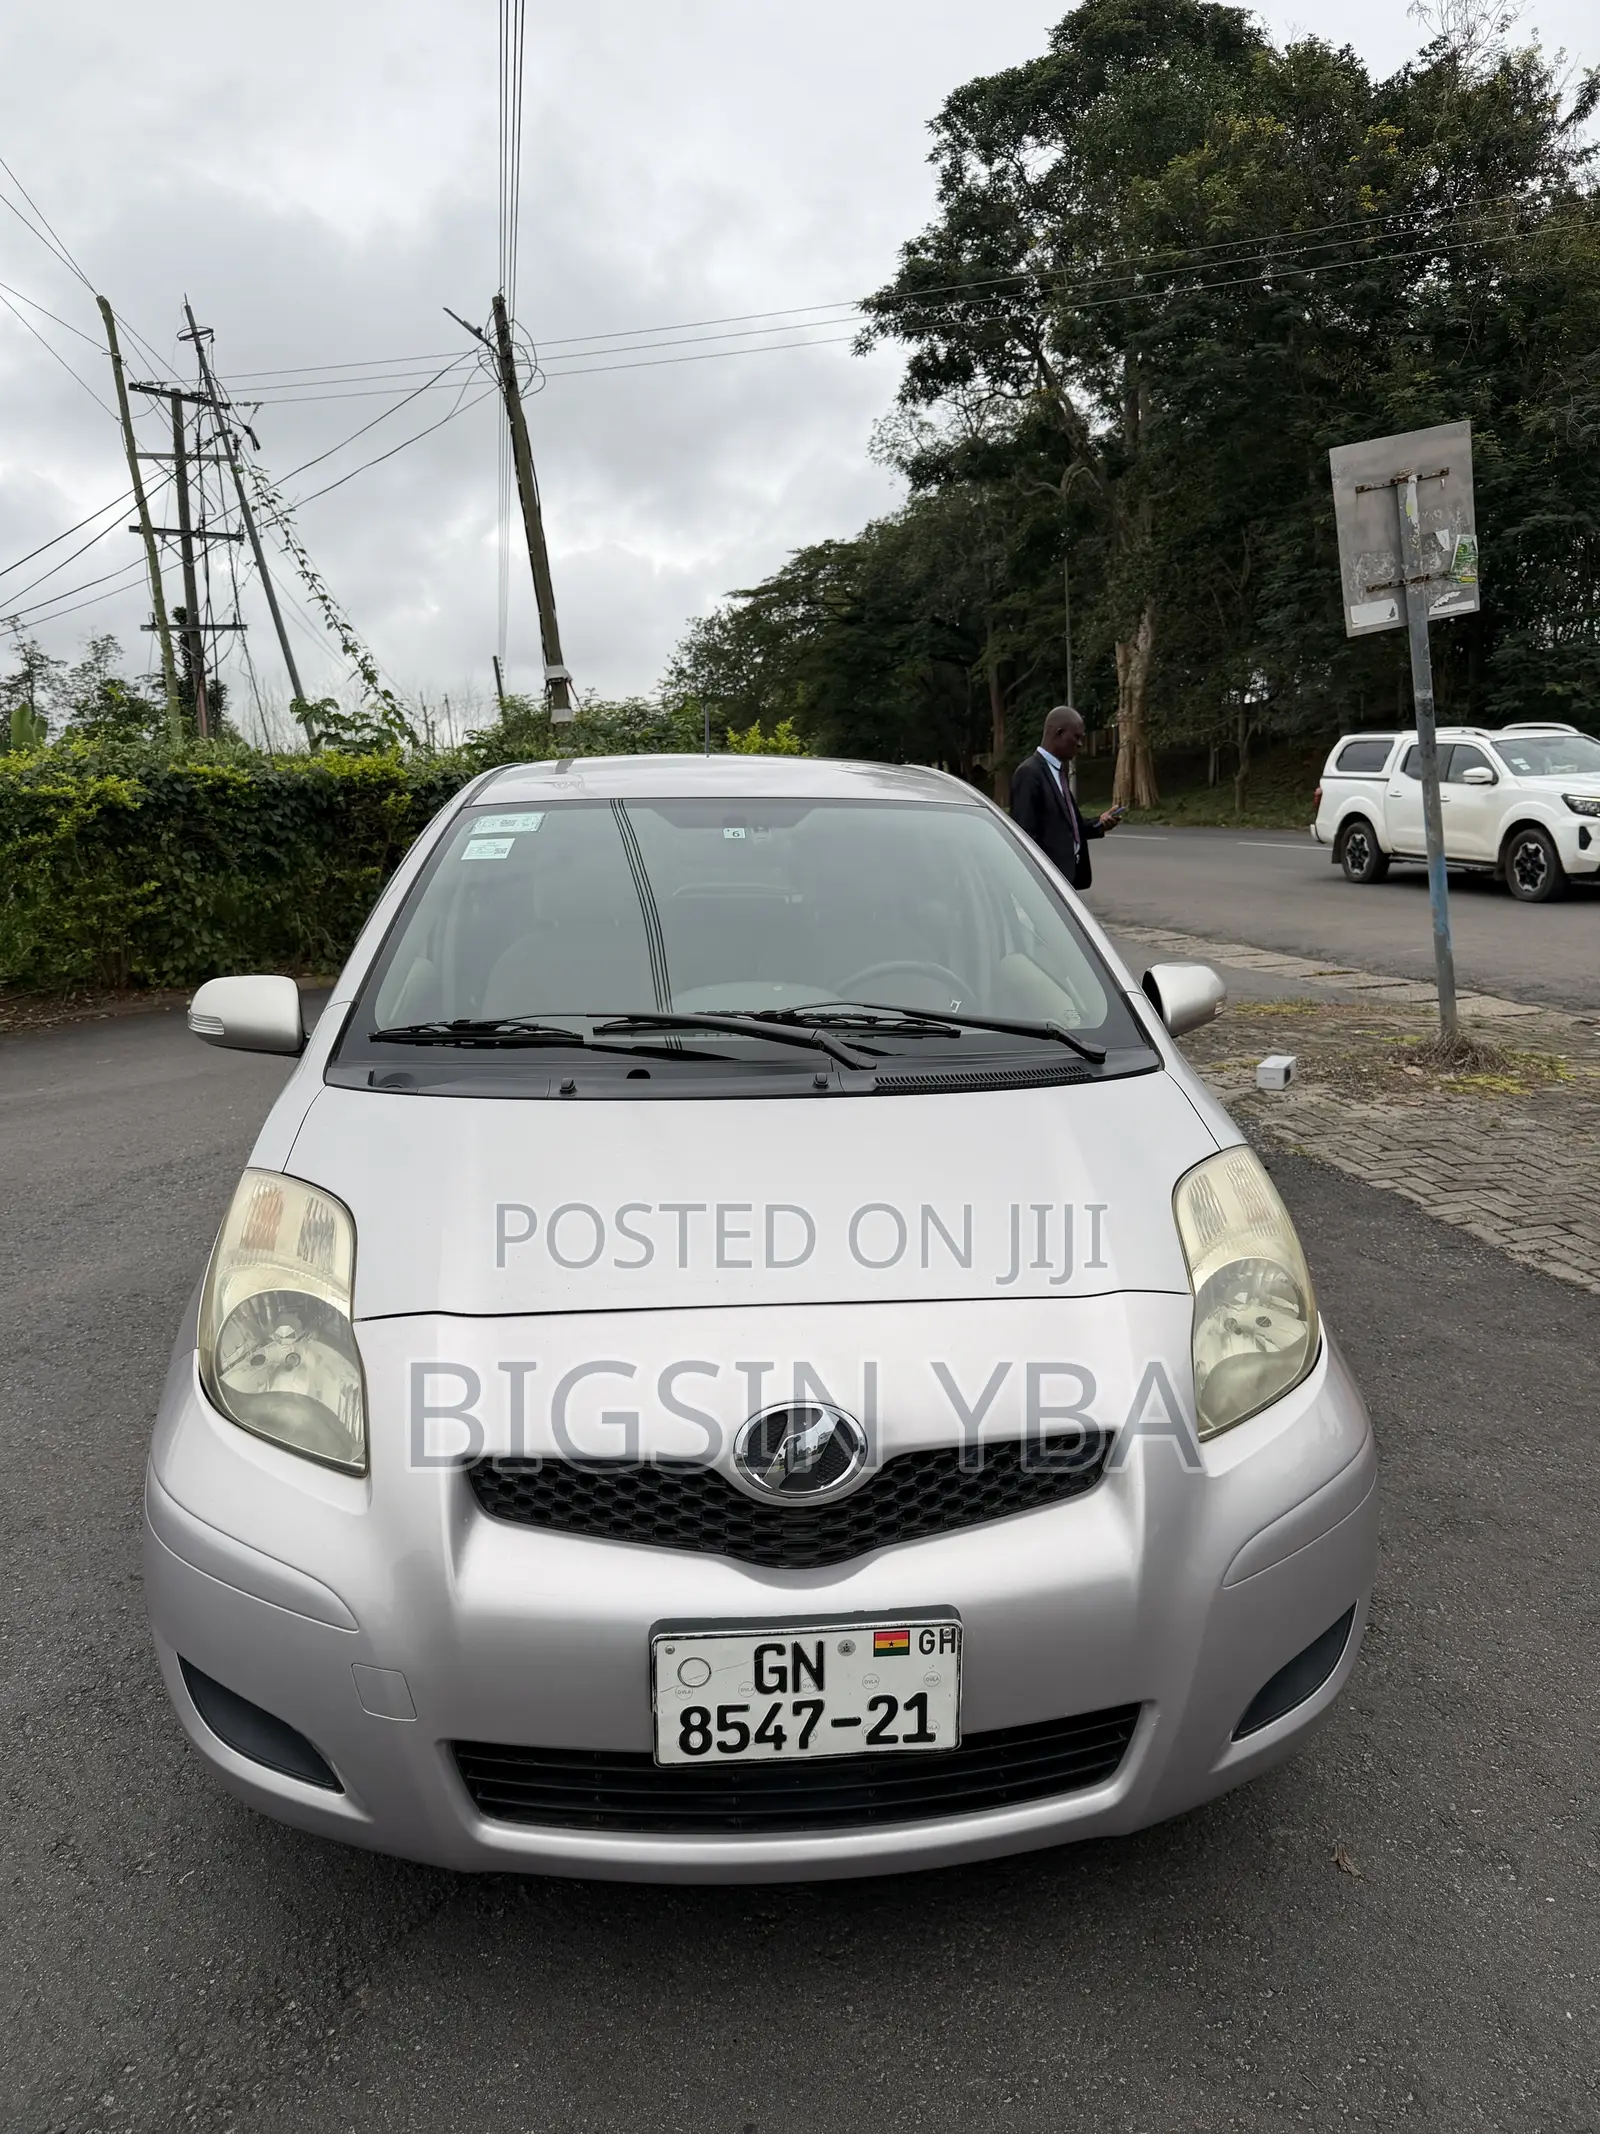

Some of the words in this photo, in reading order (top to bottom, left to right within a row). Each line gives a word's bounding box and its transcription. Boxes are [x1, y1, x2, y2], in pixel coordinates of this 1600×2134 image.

[754, 1640, 824, 1694] GN
[919, 1627, 956, 1655] GH
[679, 1692, 936, 1755] 8547-21
